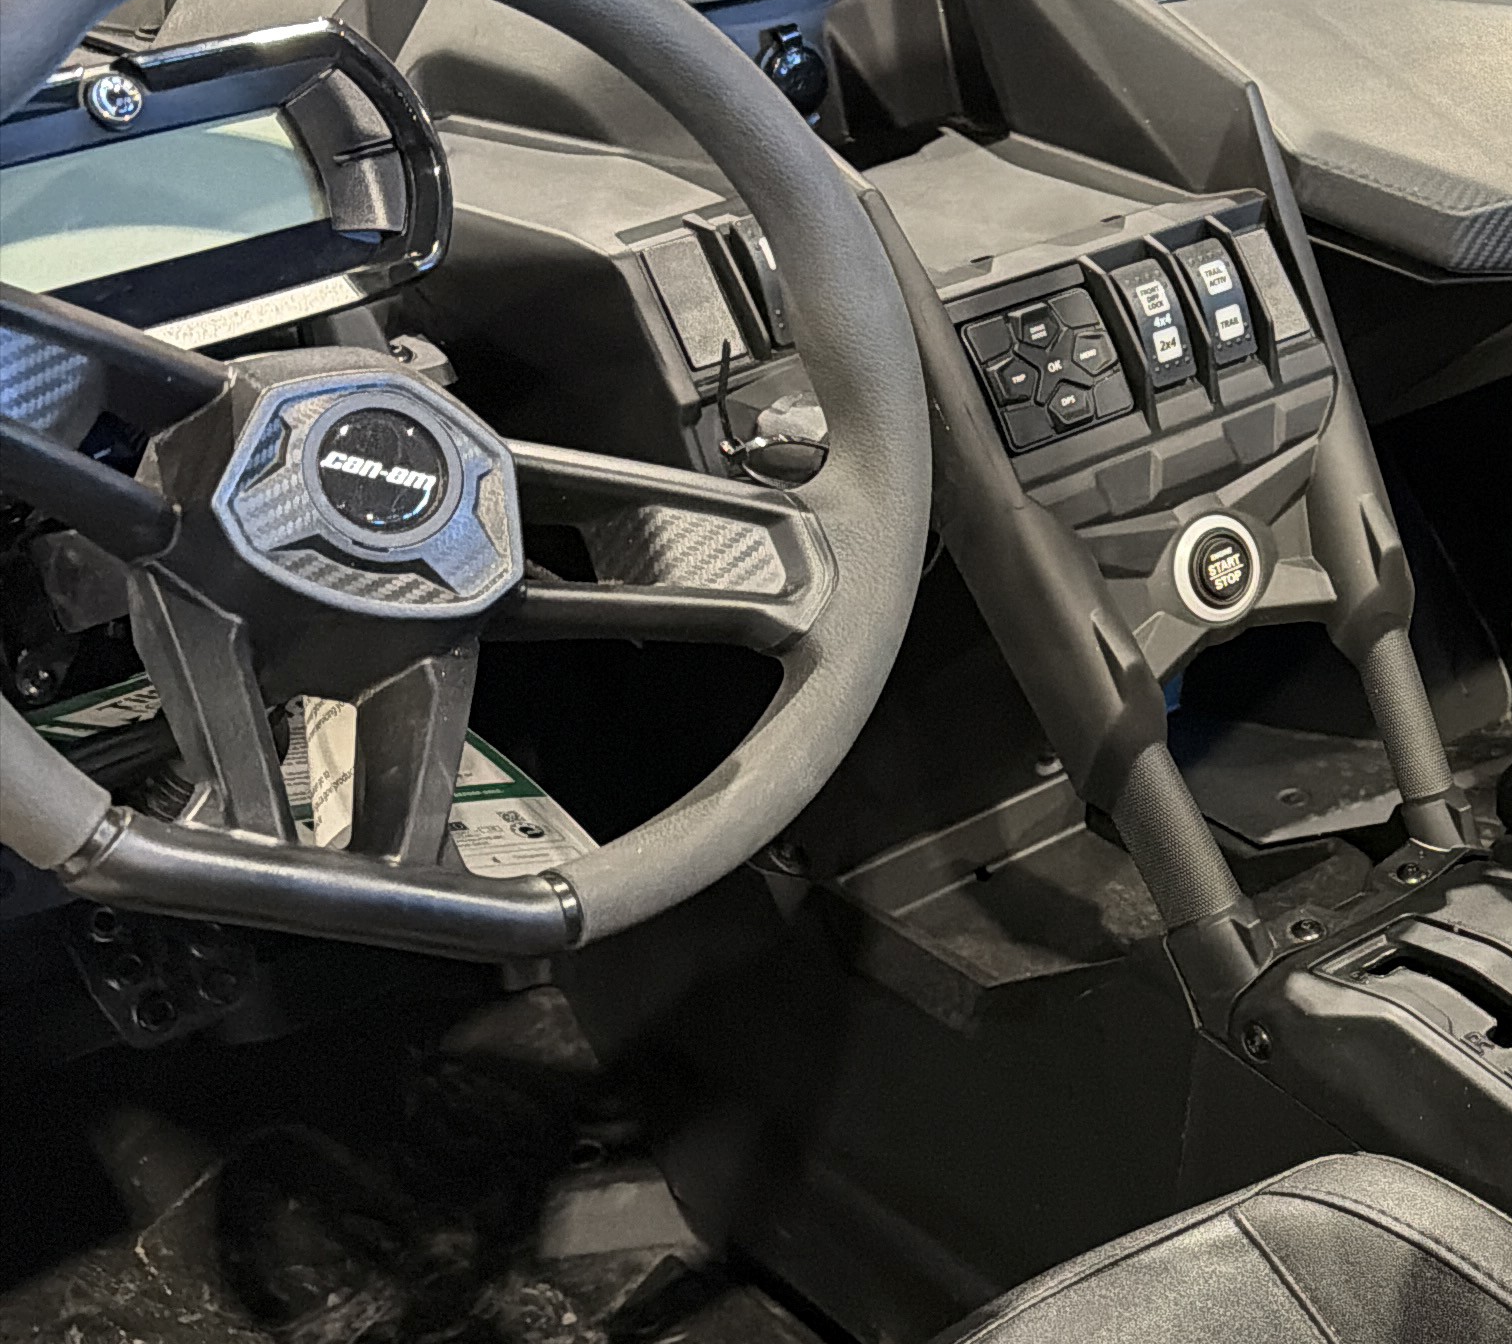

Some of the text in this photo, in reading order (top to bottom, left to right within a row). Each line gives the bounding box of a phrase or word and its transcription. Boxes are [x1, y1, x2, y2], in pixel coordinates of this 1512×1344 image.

[1204, 267, 1223, 278] TRAIL
[1209, 275, 1227, 288] ACTIV
[1147, 299, 1165, 311] LOCK
[1153, 314, 1172, 328] 4x4
[1220, 316, 1240, 330] TRAIL
[1159, 336, 1177, 351] 2x4
[1047, 359, 1062, 373] OK
[1060, 394, 1076, 407] DPS
[320, 450, 437, 491] can-am
[1208, 553, 1241, 577] START
[1214, 569, 1242, 591] STOP
